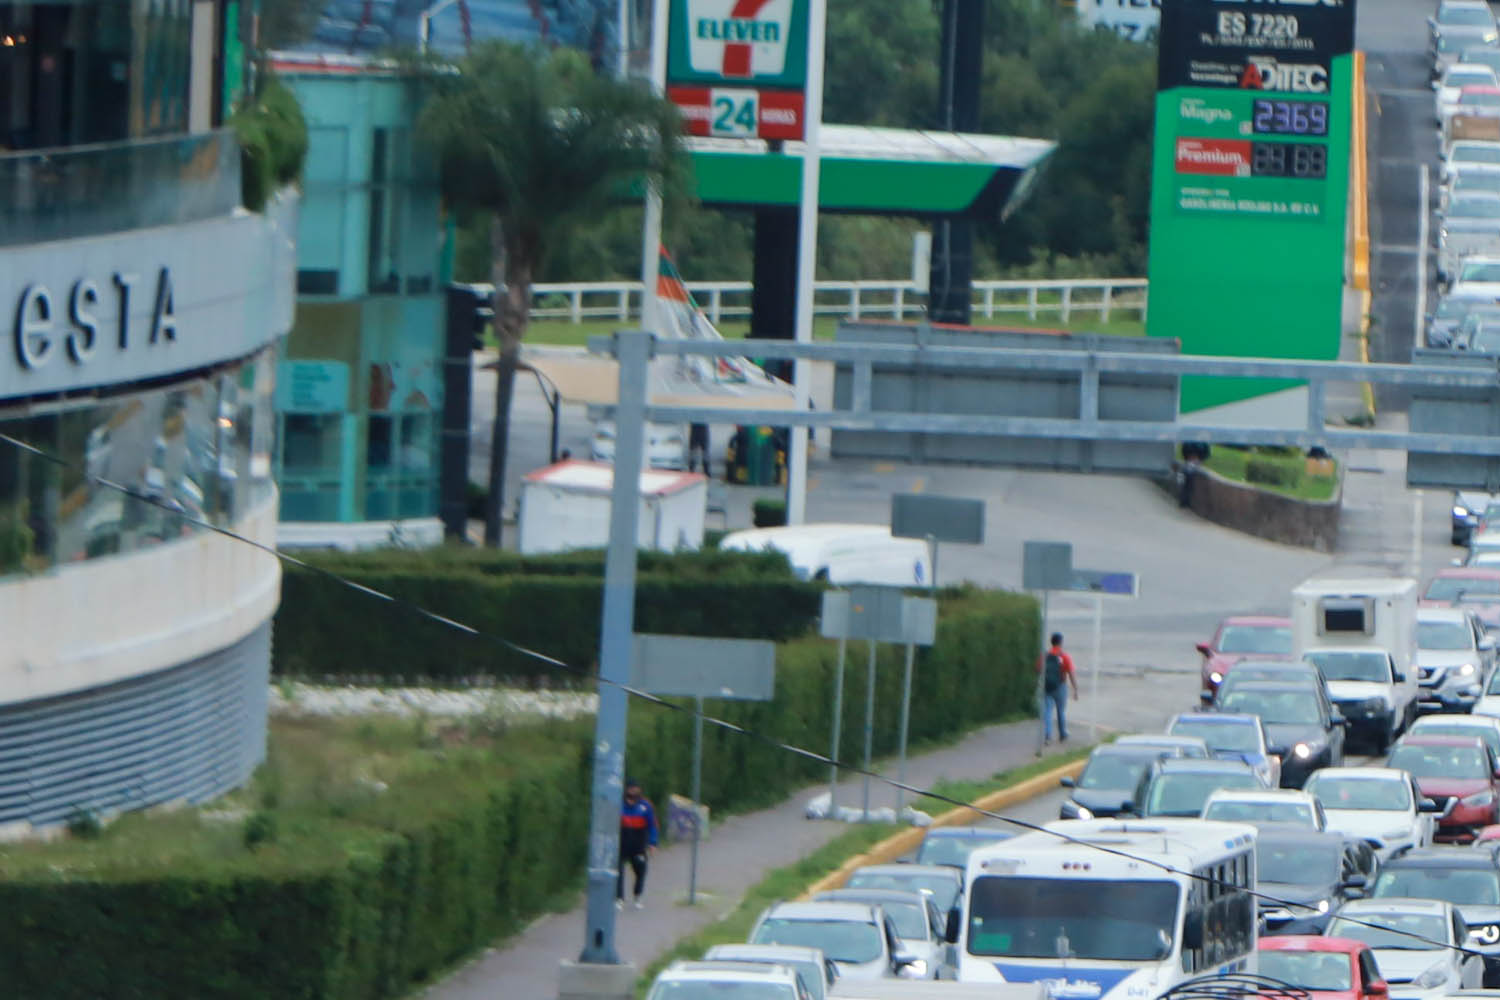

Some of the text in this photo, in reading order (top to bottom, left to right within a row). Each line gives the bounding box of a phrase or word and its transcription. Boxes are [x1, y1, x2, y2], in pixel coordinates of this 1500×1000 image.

[1218, 11, 1298, 38] ES 7220
[713, 97, 756, 131] 24
[1180, 104, 1232, 123] Magna
[1177, 147, 1242, 164] Premium
